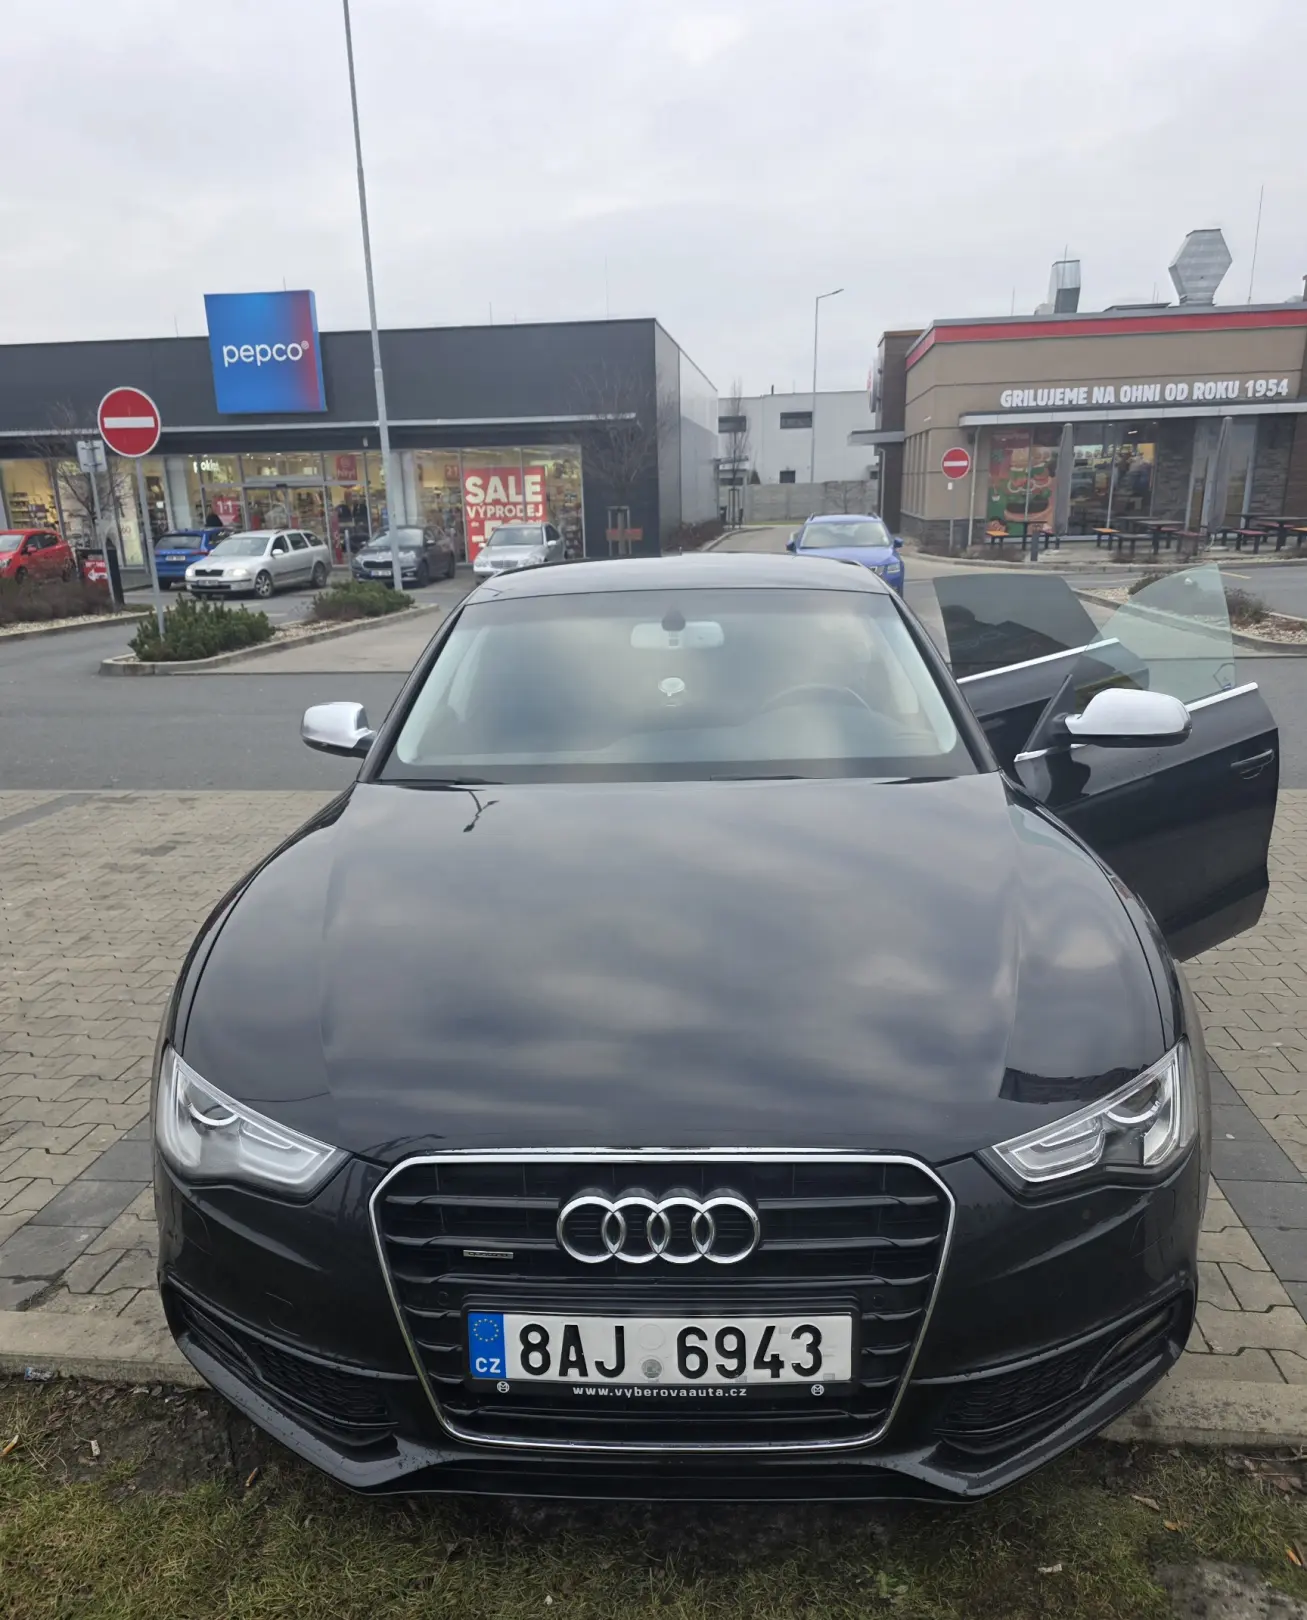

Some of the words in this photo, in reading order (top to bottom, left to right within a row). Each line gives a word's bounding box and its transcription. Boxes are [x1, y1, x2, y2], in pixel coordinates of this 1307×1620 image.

[1000, 387, 1089, 408] GRILUJEME
[1091, 386, 1116, 404] NA
[1119, 384, 1161, 403] OHNI
[1164, 382, 1189, 401] OD
[1192, 381, 1240, 400] ROKU
[1244, 378, 1289, 398] 1954
[465, 475, 543, 504] SALE
[475, 1357, 501, 1373] CZ
[519, 1323, 626, 1379] 8AJ
[676, 1324, 823, 1380] 6943
[572, 1386, 747, 1398] www.vyberovaauta.cz
